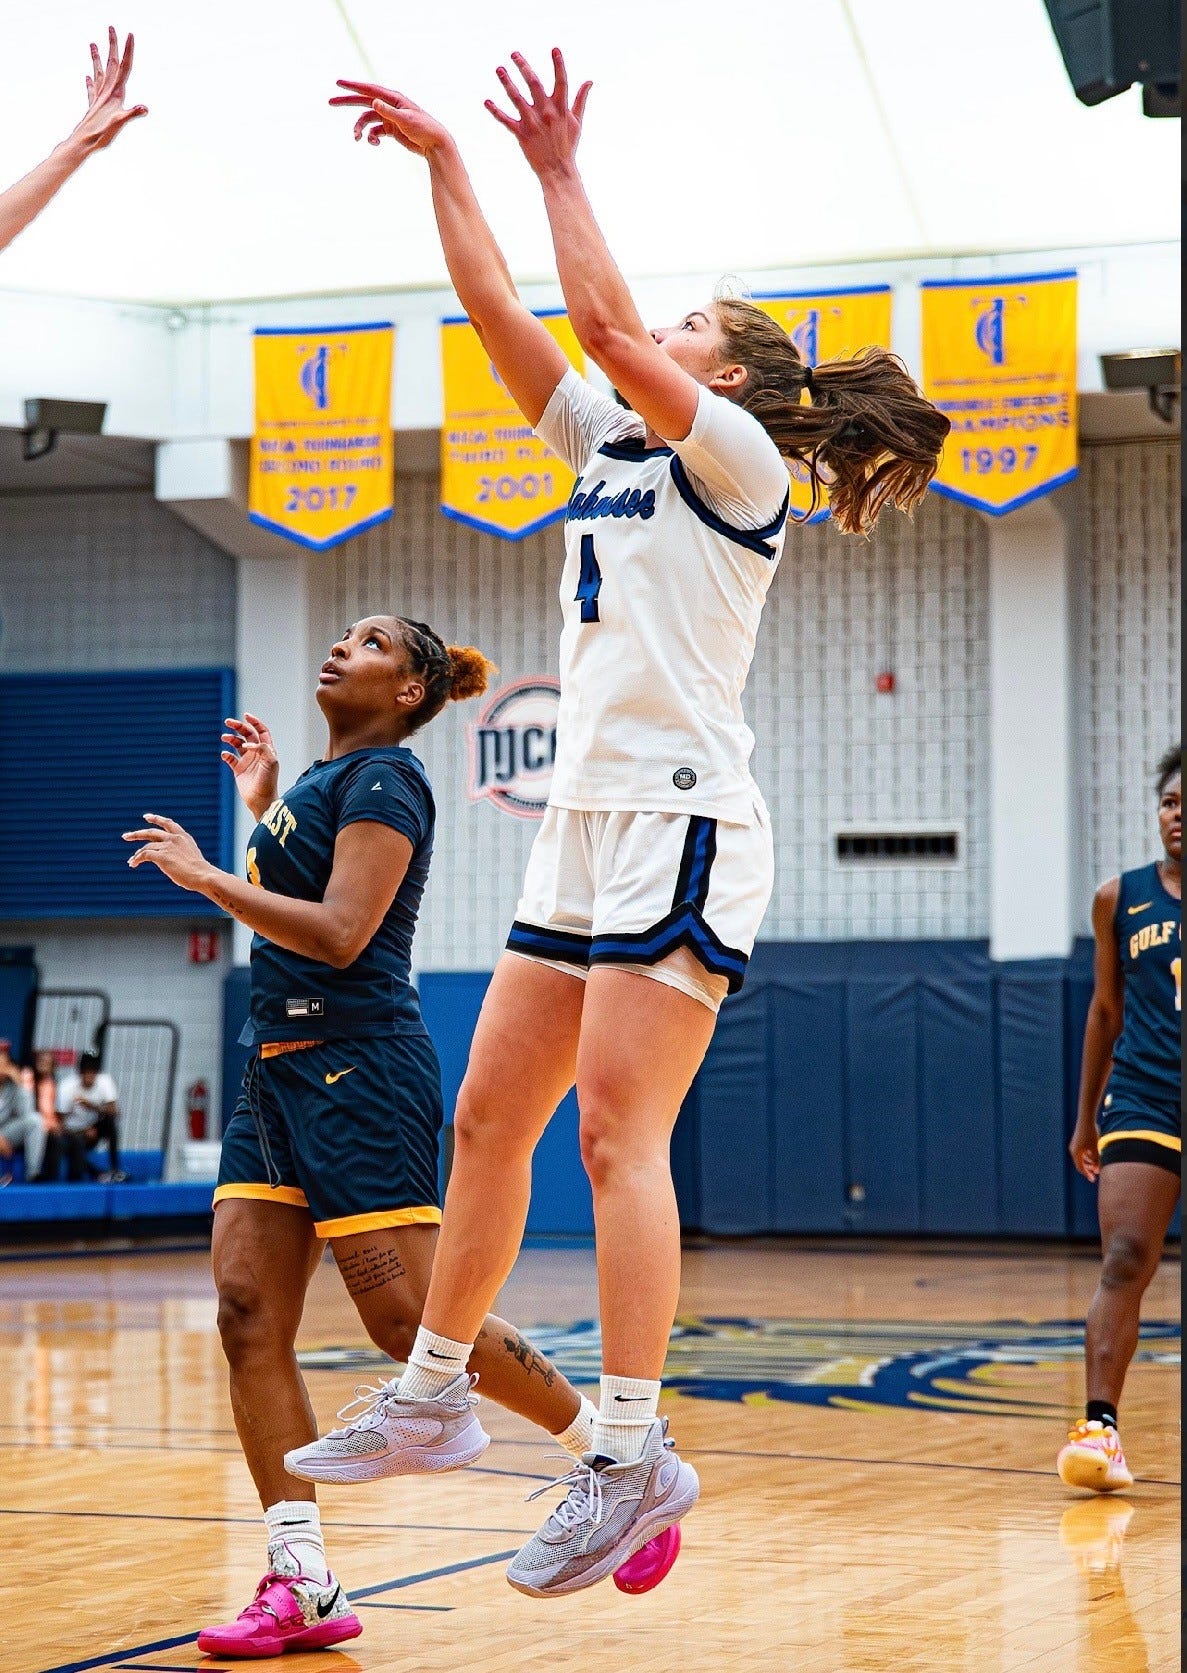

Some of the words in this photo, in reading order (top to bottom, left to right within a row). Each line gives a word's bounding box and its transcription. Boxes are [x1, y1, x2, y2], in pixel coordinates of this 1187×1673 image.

[960, 444, 1039, 475] 1997
[286, 483, 357, 512] 2017
[478, 472, 553, 502] 2001
[574, 533, 603, 623] 4
[1129, 920, 1176, 960] GULF
[311, 1002, 320, 1012] M
